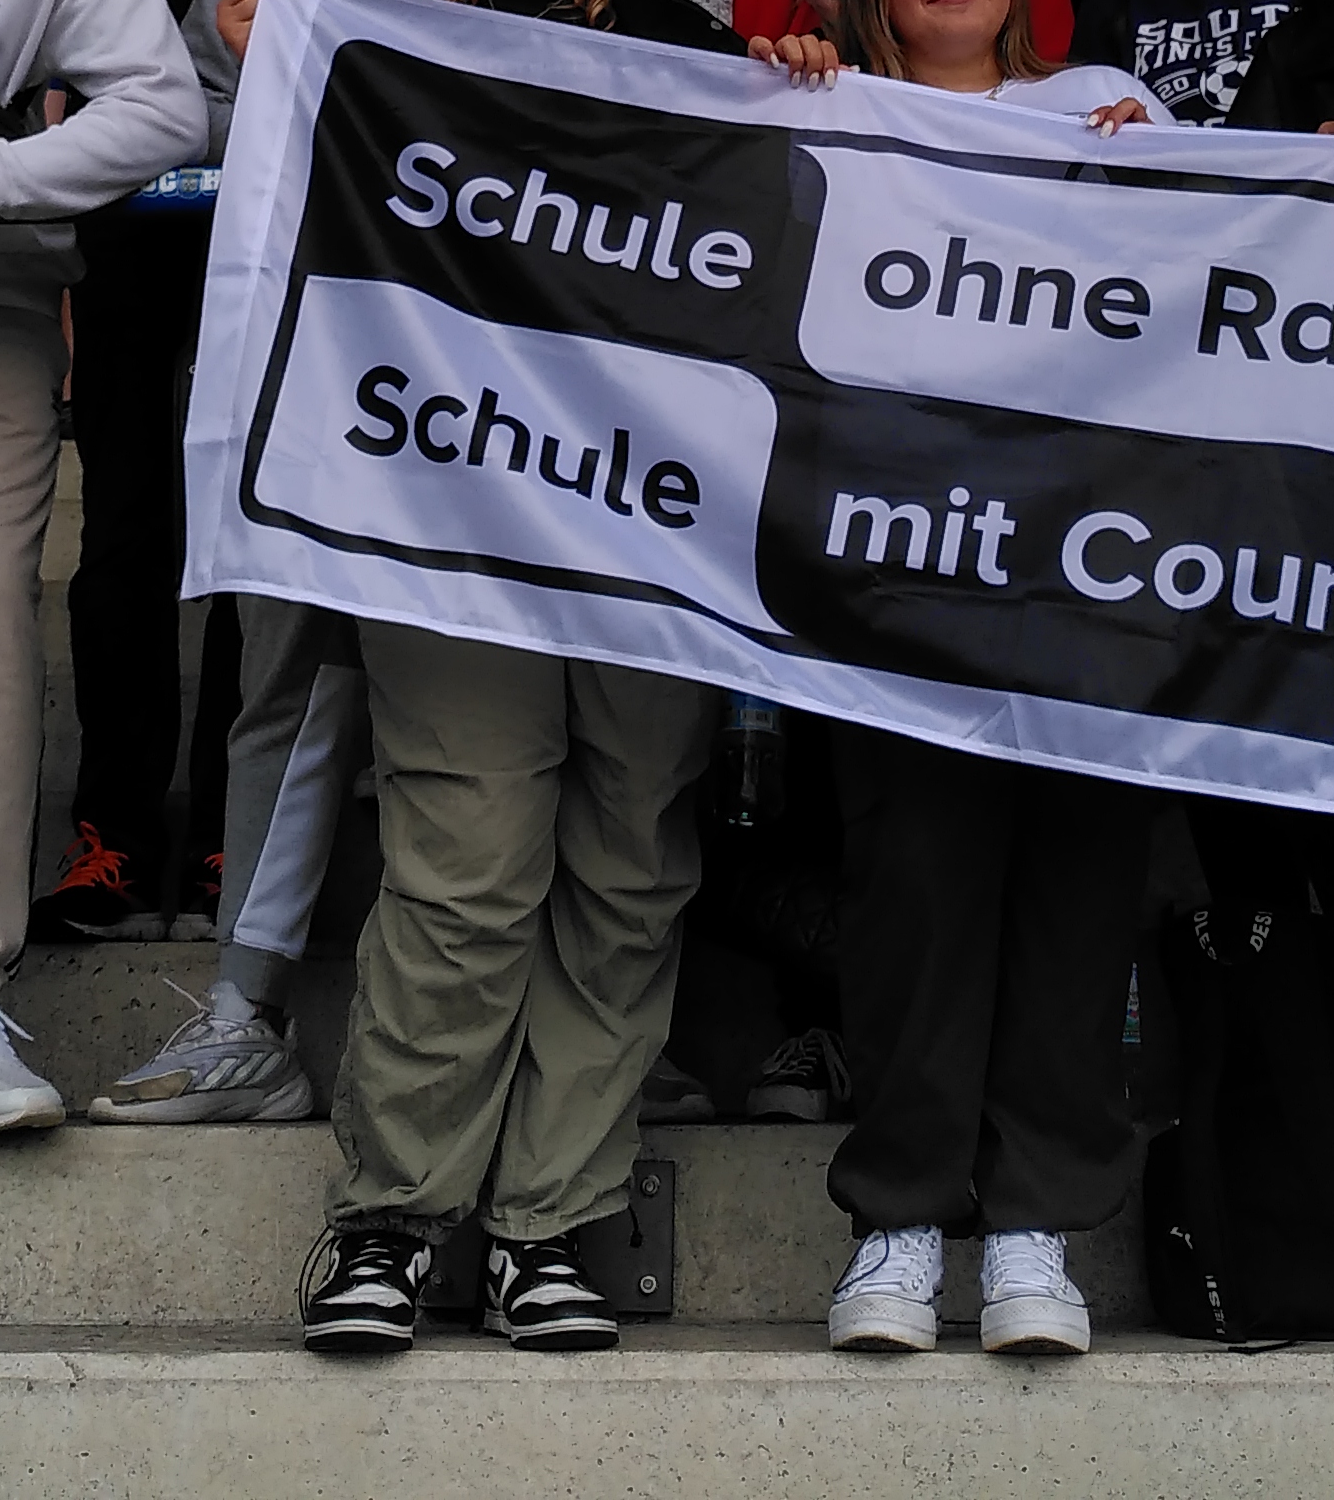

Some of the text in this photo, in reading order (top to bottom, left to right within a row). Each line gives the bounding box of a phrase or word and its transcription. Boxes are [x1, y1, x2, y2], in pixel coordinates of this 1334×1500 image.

[1135, 3, 1302, 45] SOUT
[1157, 75, 1191, 100] 20
[385, 139, 755, 291] Schule
[863, 238, 1151, 339] ohne
[344, 366, 701, 528] Schule
[825, 486, 1017, 587] mit
